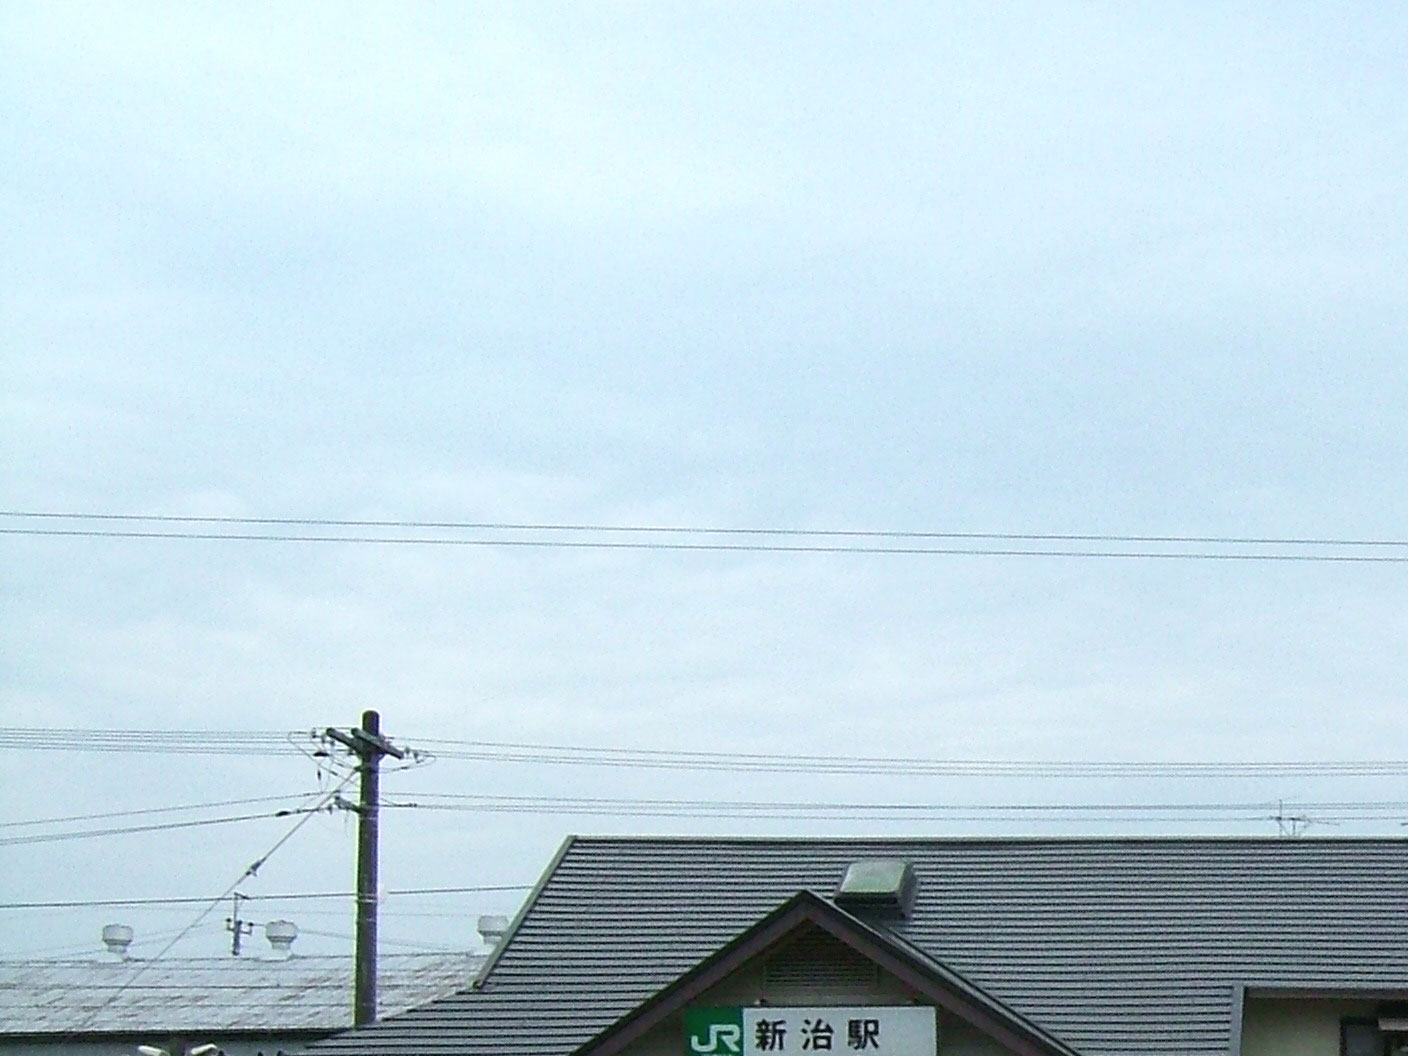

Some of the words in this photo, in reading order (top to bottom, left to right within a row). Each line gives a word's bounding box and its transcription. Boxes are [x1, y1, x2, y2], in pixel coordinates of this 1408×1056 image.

[690, 1023, 741, 1052] JR
[755, 1018, 880, 1051] 新治駅
